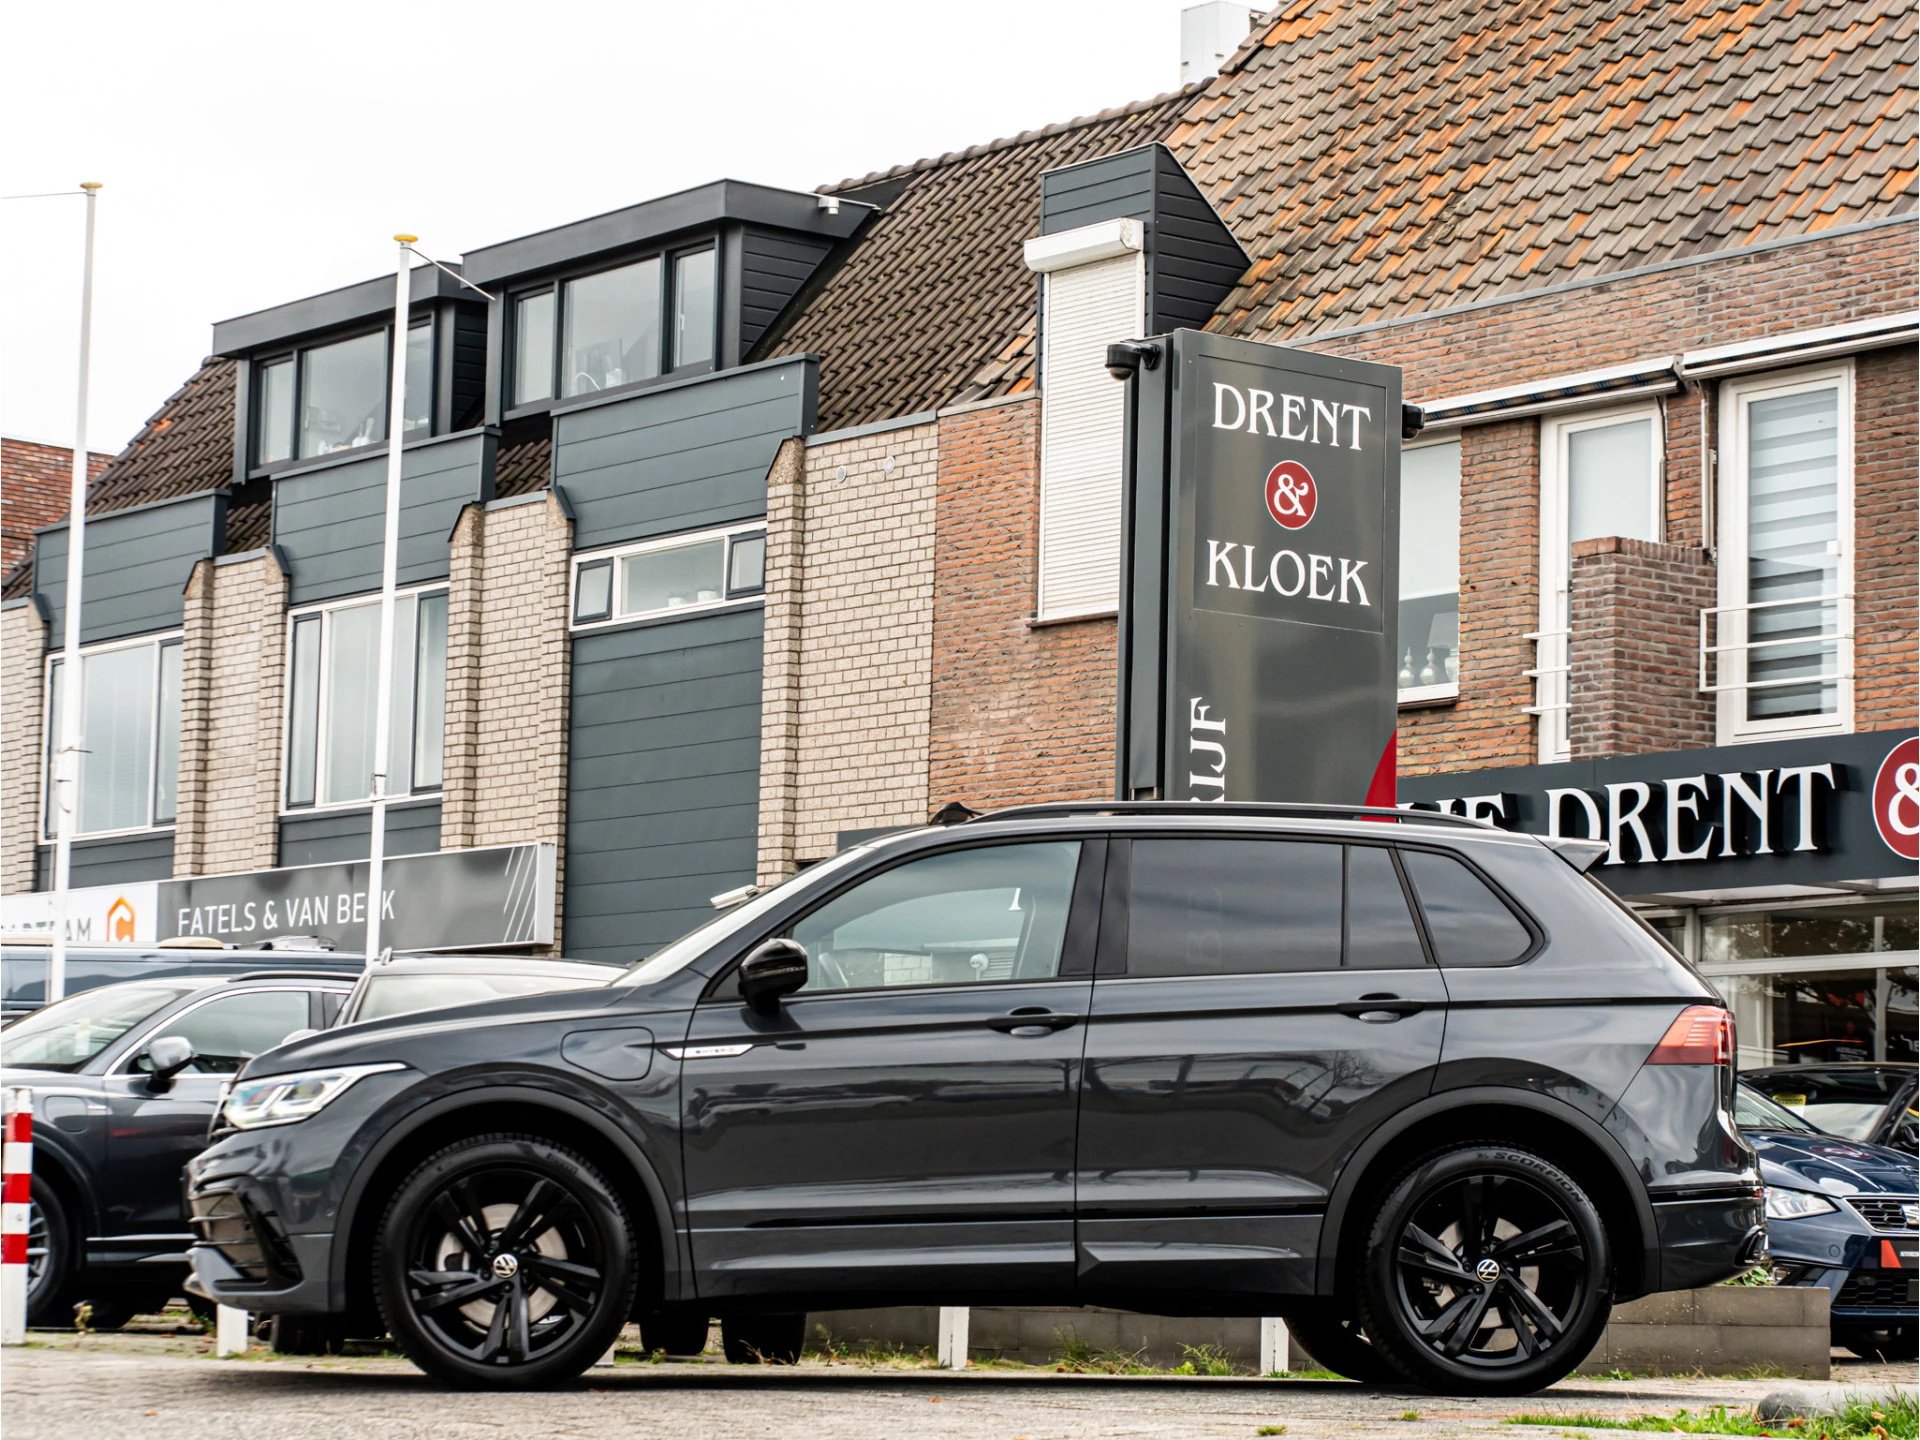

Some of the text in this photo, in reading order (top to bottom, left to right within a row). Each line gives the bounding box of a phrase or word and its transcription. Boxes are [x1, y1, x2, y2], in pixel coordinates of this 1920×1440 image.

[1212, 382, 1371, 451] DRENT
[1273, 474, 1308, 517] &
[1206, 539, 1371, 606] KLOEK
[1190, 697, 1226, 801] IJF
[1545, 763, 1836, 866] DRENT
[178, 889, 396, 936] FATELS & VAN BEK
[1494, 1151, 1584, 1203] SCORPION
